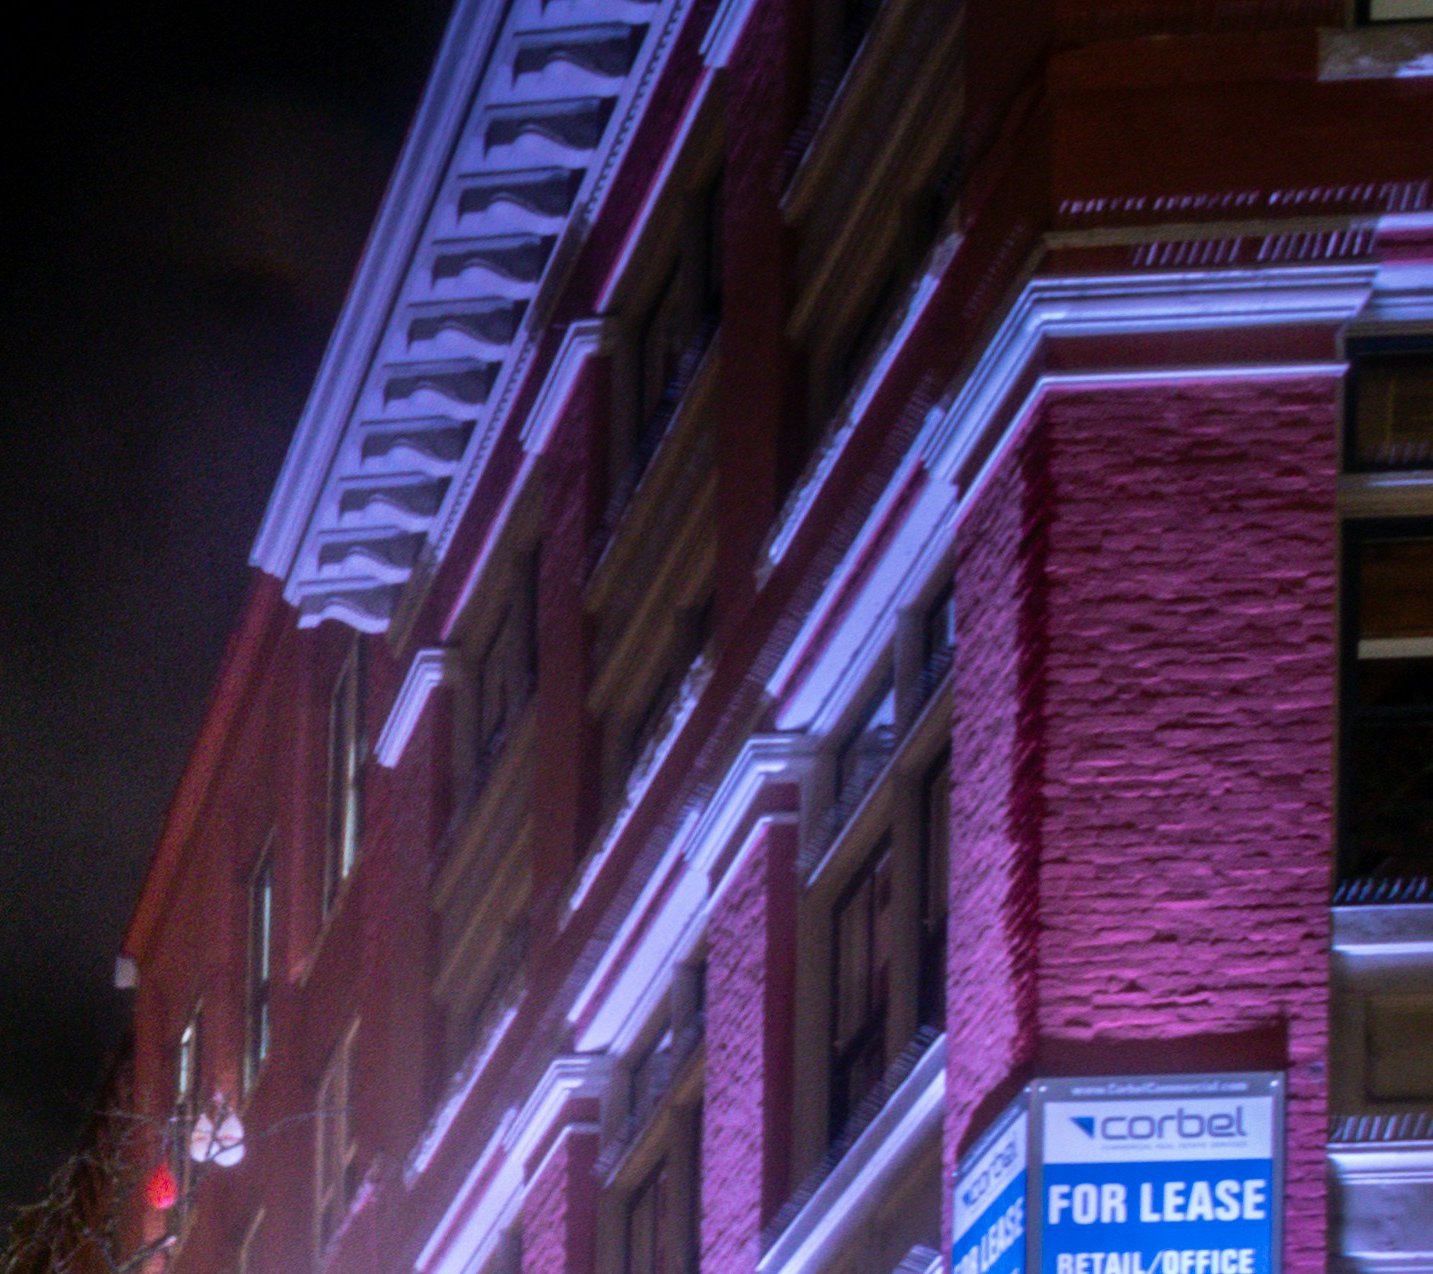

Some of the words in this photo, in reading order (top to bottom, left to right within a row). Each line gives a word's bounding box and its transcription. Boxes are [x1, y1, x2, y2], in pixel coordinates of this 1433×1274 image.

[1101, 1106, 1247, 1141] corbel
[1048, 1182, 1128, 1225] FOR
[1140, 1179, 1267, 1223] LEASE
